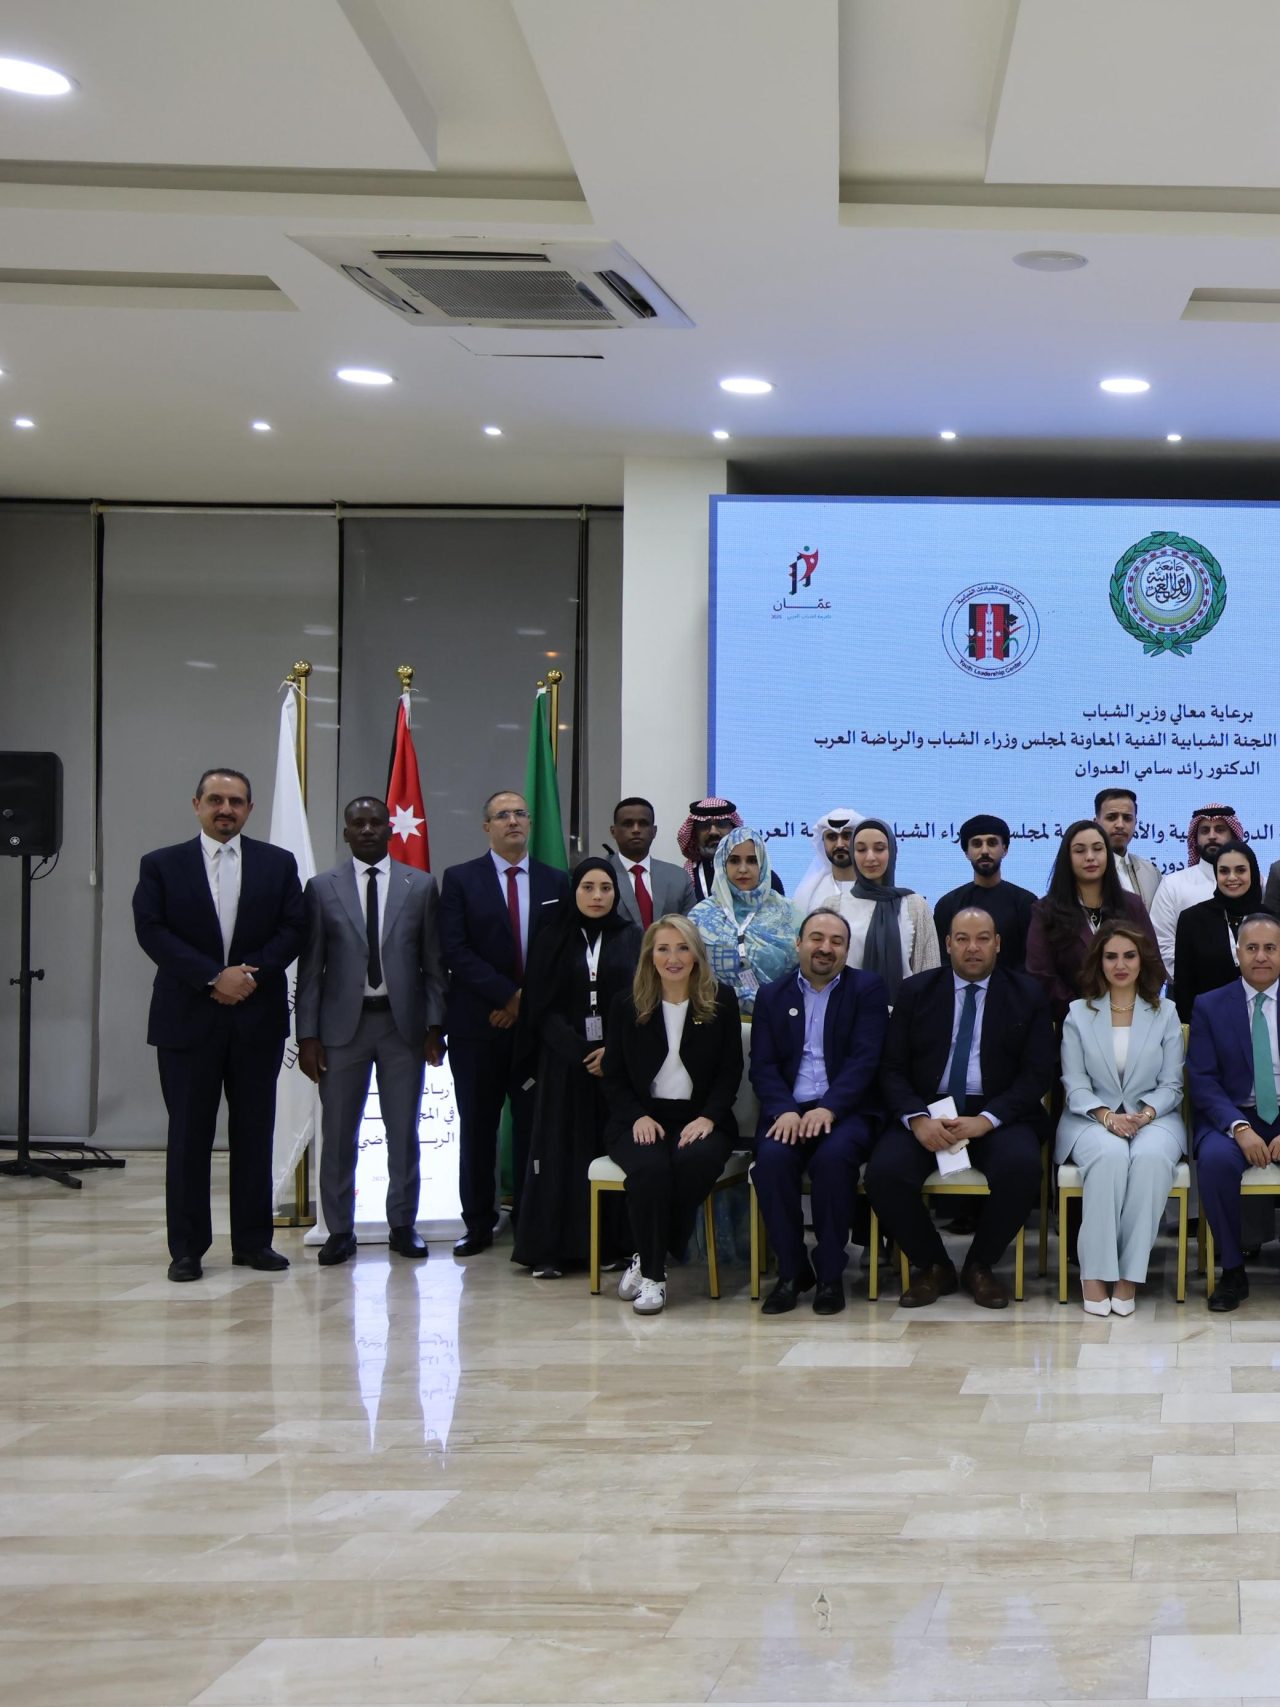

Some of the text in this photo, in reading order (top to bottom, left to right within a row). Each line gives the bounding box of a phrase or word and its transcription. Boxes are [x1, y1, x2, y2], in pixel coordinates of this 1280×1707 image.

[960, 659, 1022, 677] Youth Leadership Center
[1083, 704, 1254, 725] برعاية معالي وزير الشباب
[814, 730, 856, 749] العرب
[861, 730, 924, 751] والرياضة
[928, 731, 979, 748] الشباب
[984, 732, 1018, 750] وزراء
[1022, 731, 1067, 750] لمجلس
[1071, 732, 1121, 750] المعاونة
[1125, 732, 1167, 749] الفنية
[1171, 733, 1229, 750] الشبابية
[1234, 733, 1277, 750] اللجنة
[1075, 760, 1260, 782] الدكتور رائد سامي العدوان
[894, 822, 935, 840] الشبا
[1243, 824, 1273, 844] الدو
[444, 1107, 455, 1124] في
